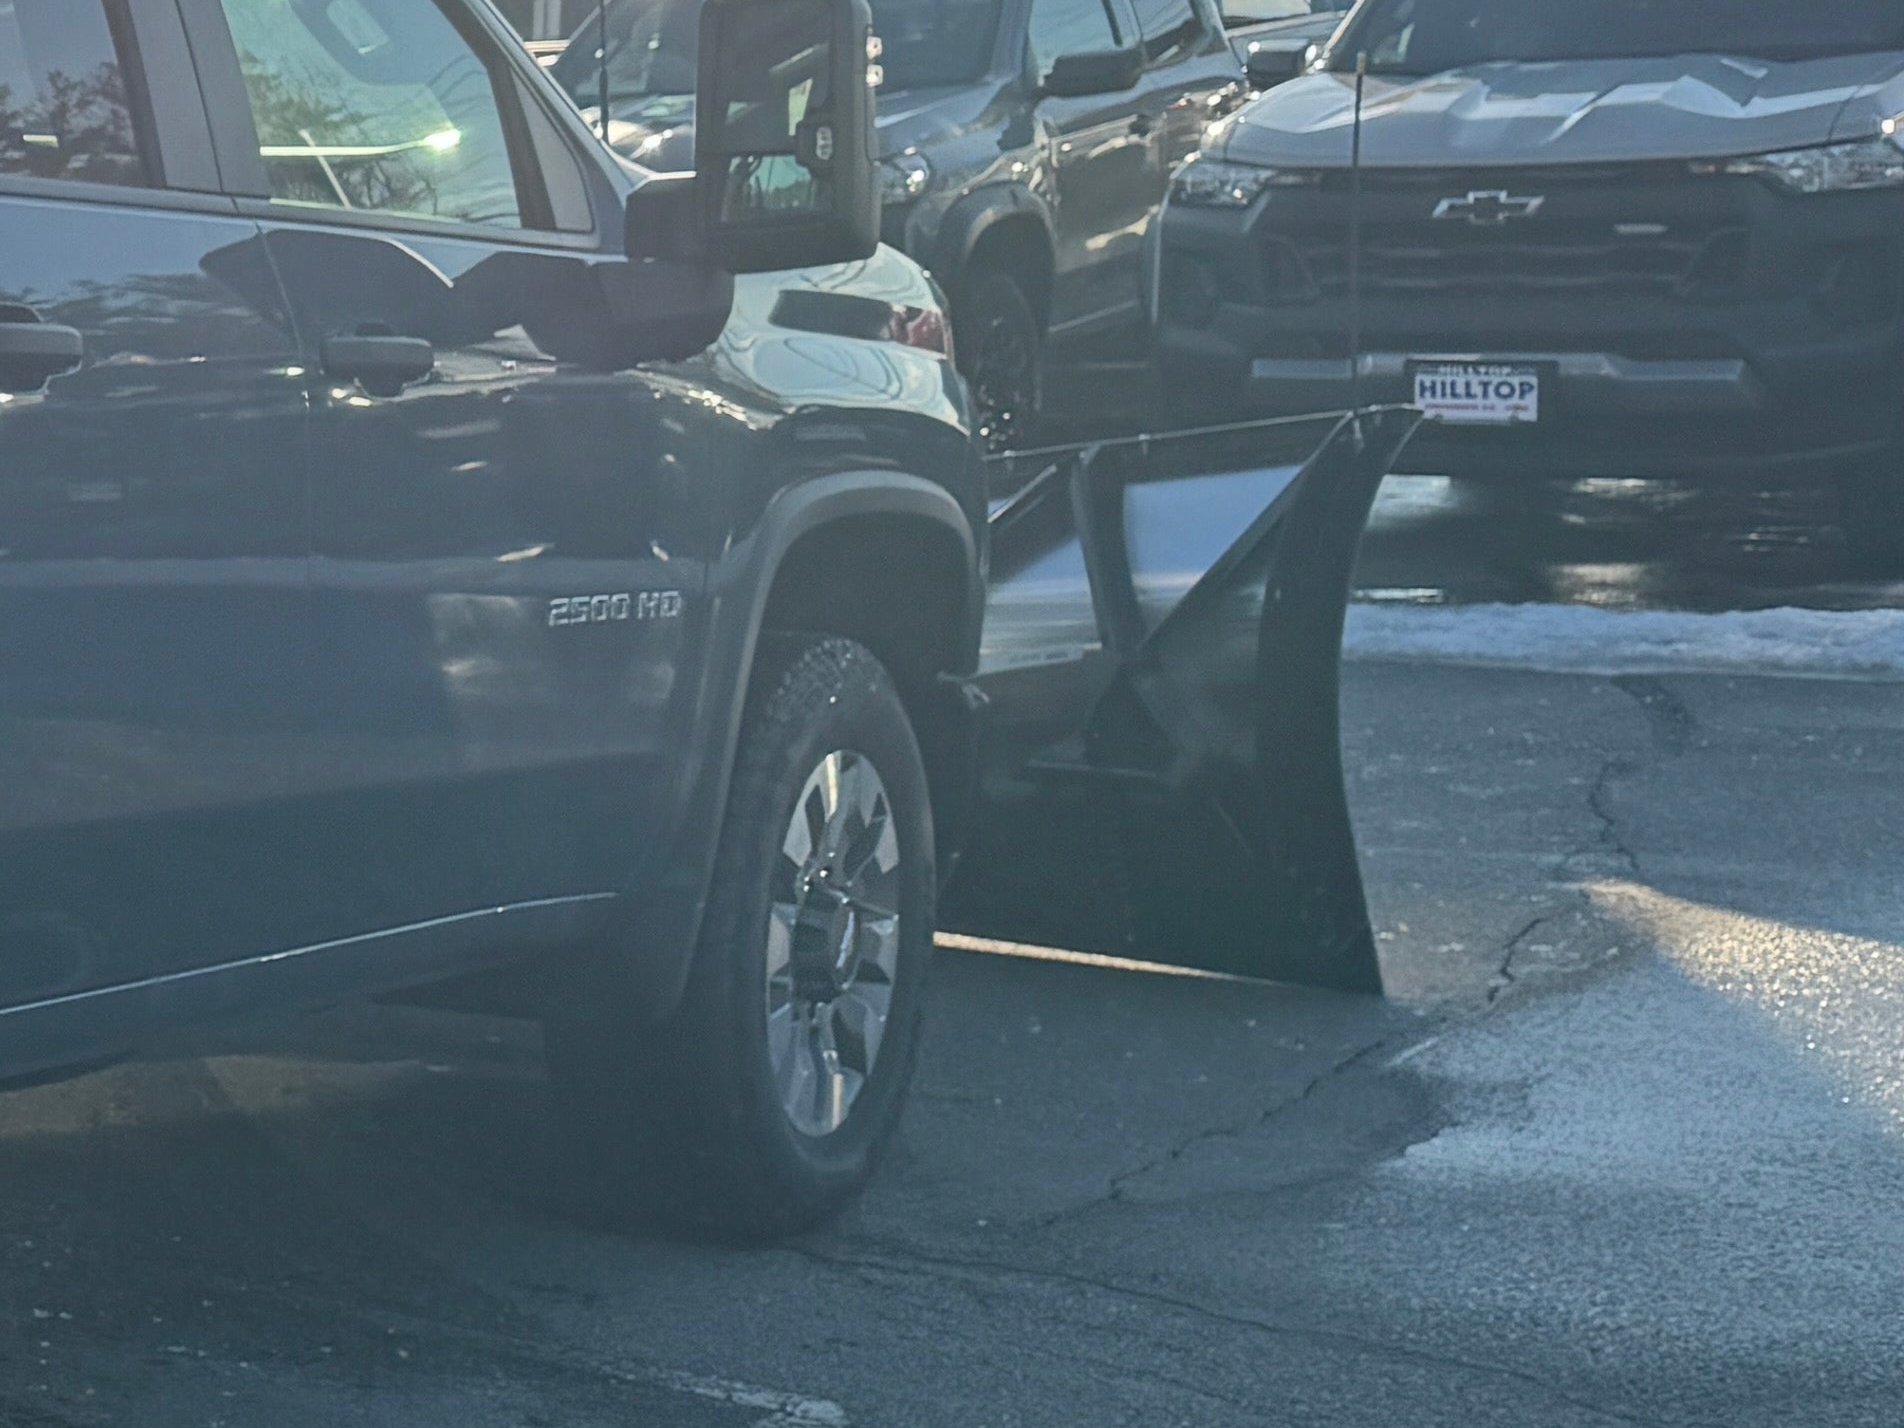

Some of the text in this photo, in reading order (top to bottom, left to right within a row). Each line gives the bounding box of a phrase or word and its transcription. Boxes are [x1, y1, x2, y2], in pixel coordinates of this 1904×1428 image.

[1418, 379, 1535, 400] HILLTOP
[548, 590, 682, 627] 2500 HD
